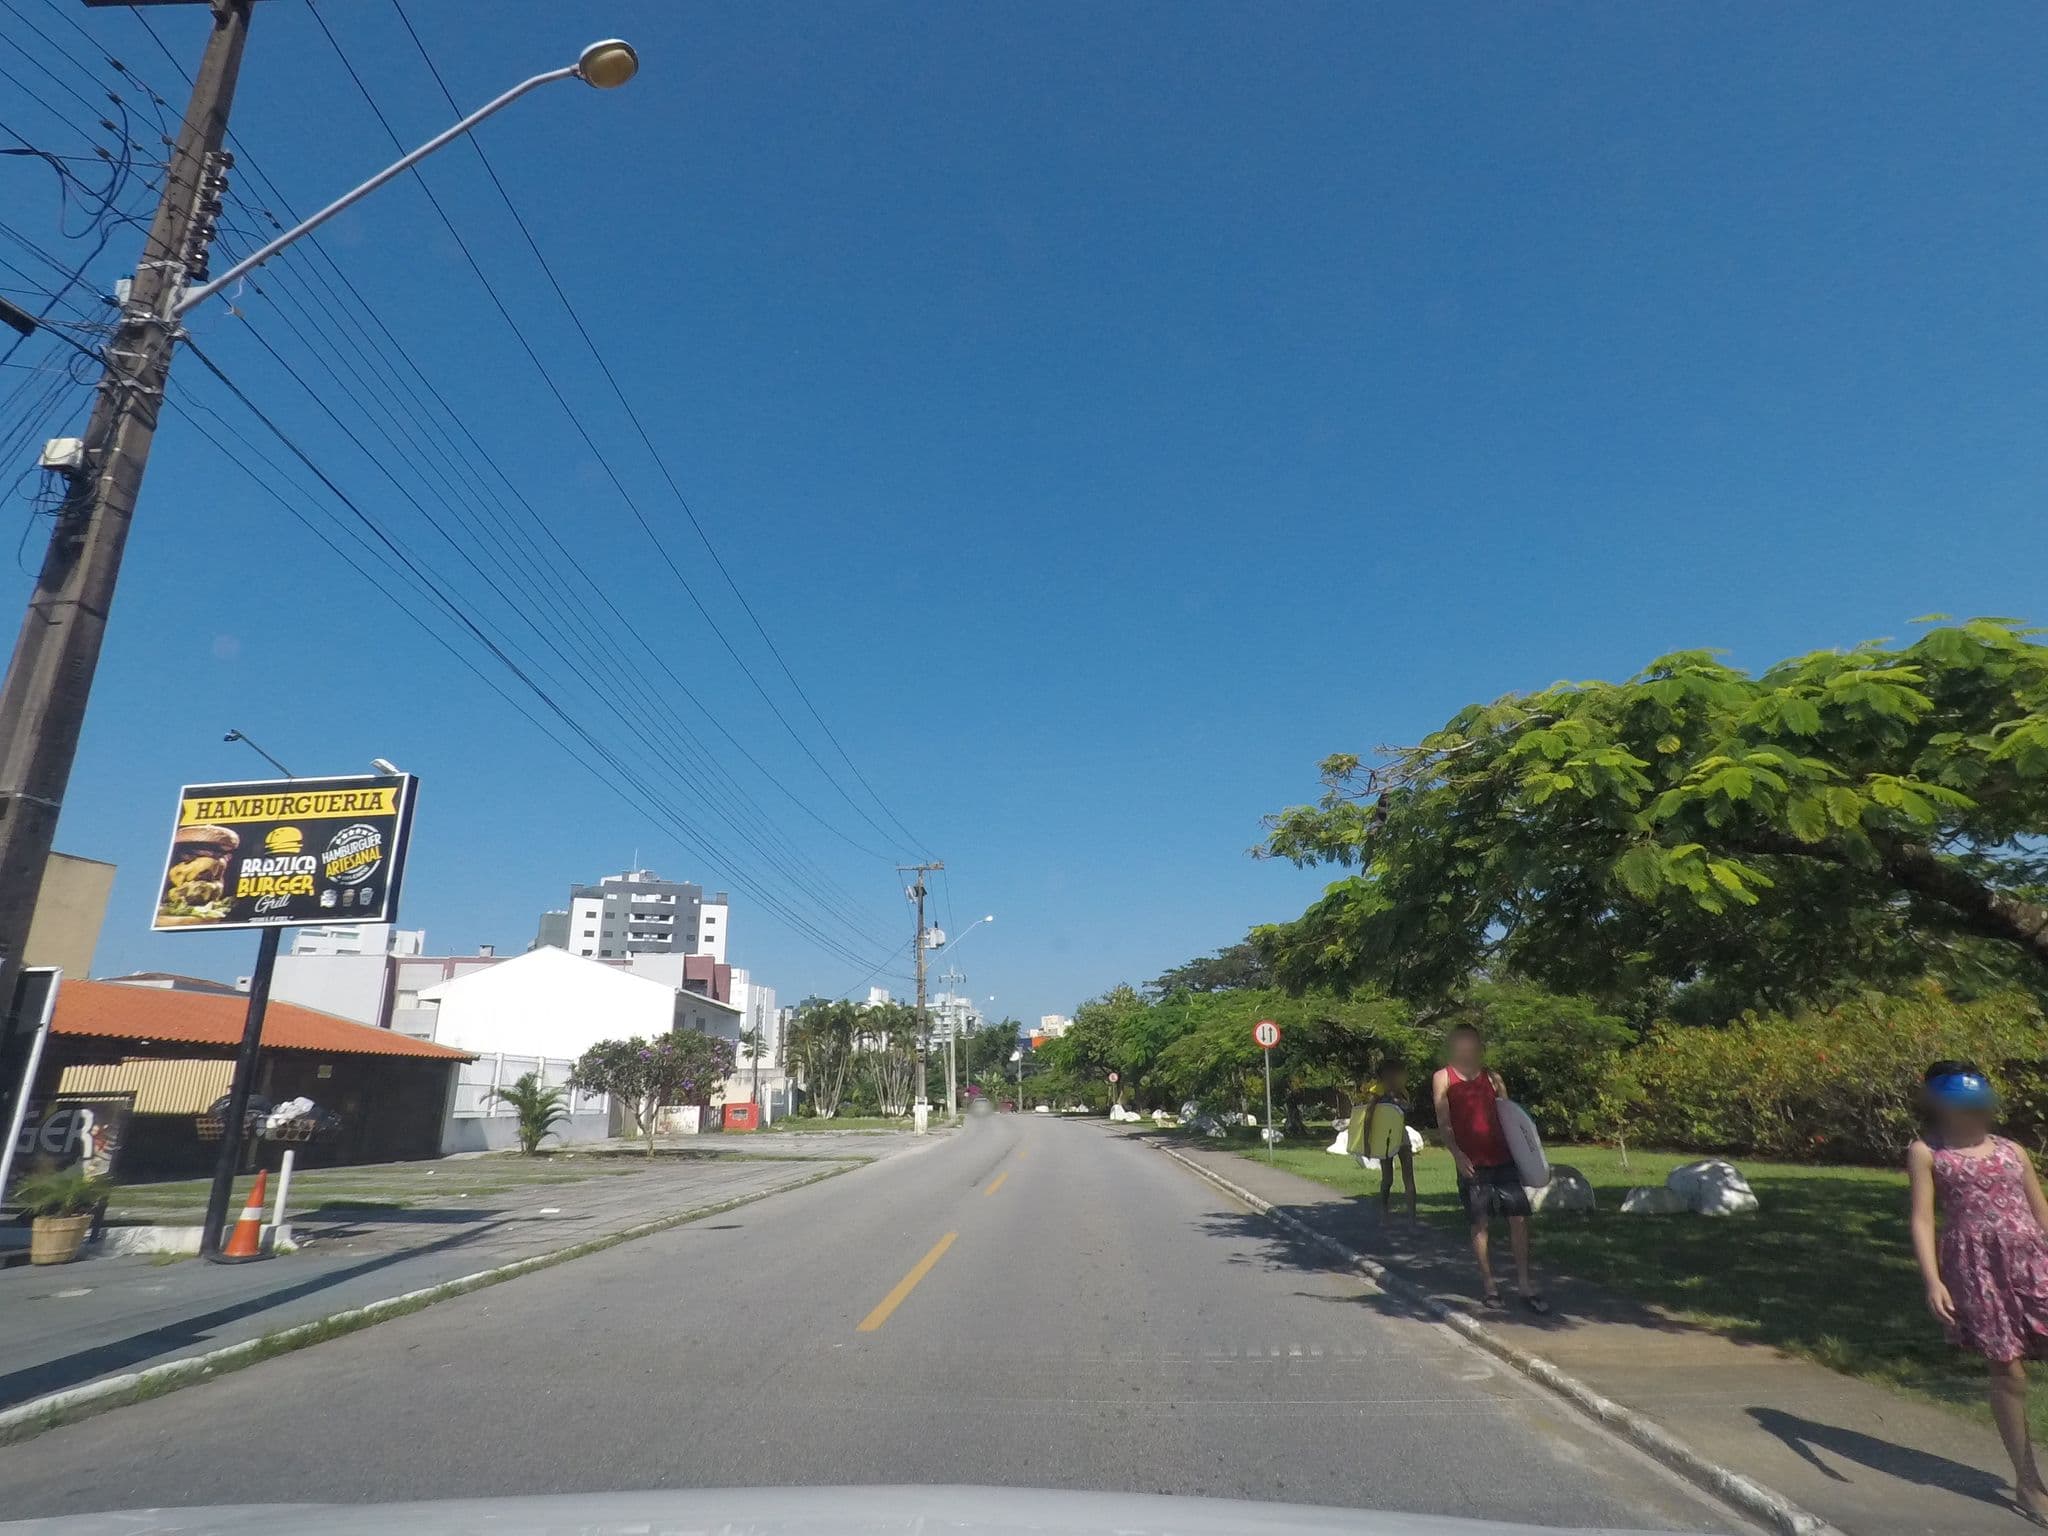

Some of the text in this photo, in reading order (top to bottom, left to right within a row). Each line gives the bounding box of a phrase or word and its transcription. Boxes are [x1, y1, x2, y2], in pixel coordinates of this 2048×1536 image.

[195, 792, 384, 820] HAMBURGUERIA
[321, 833, 382, 864] HAMBURGUER
[240, 855, 317, 877] BRAZUCA
[325, 845, 383, 878] ARTESANAL
[236, 875, 315, 897] BURGER
[254, 894, 291, 913] Grill
